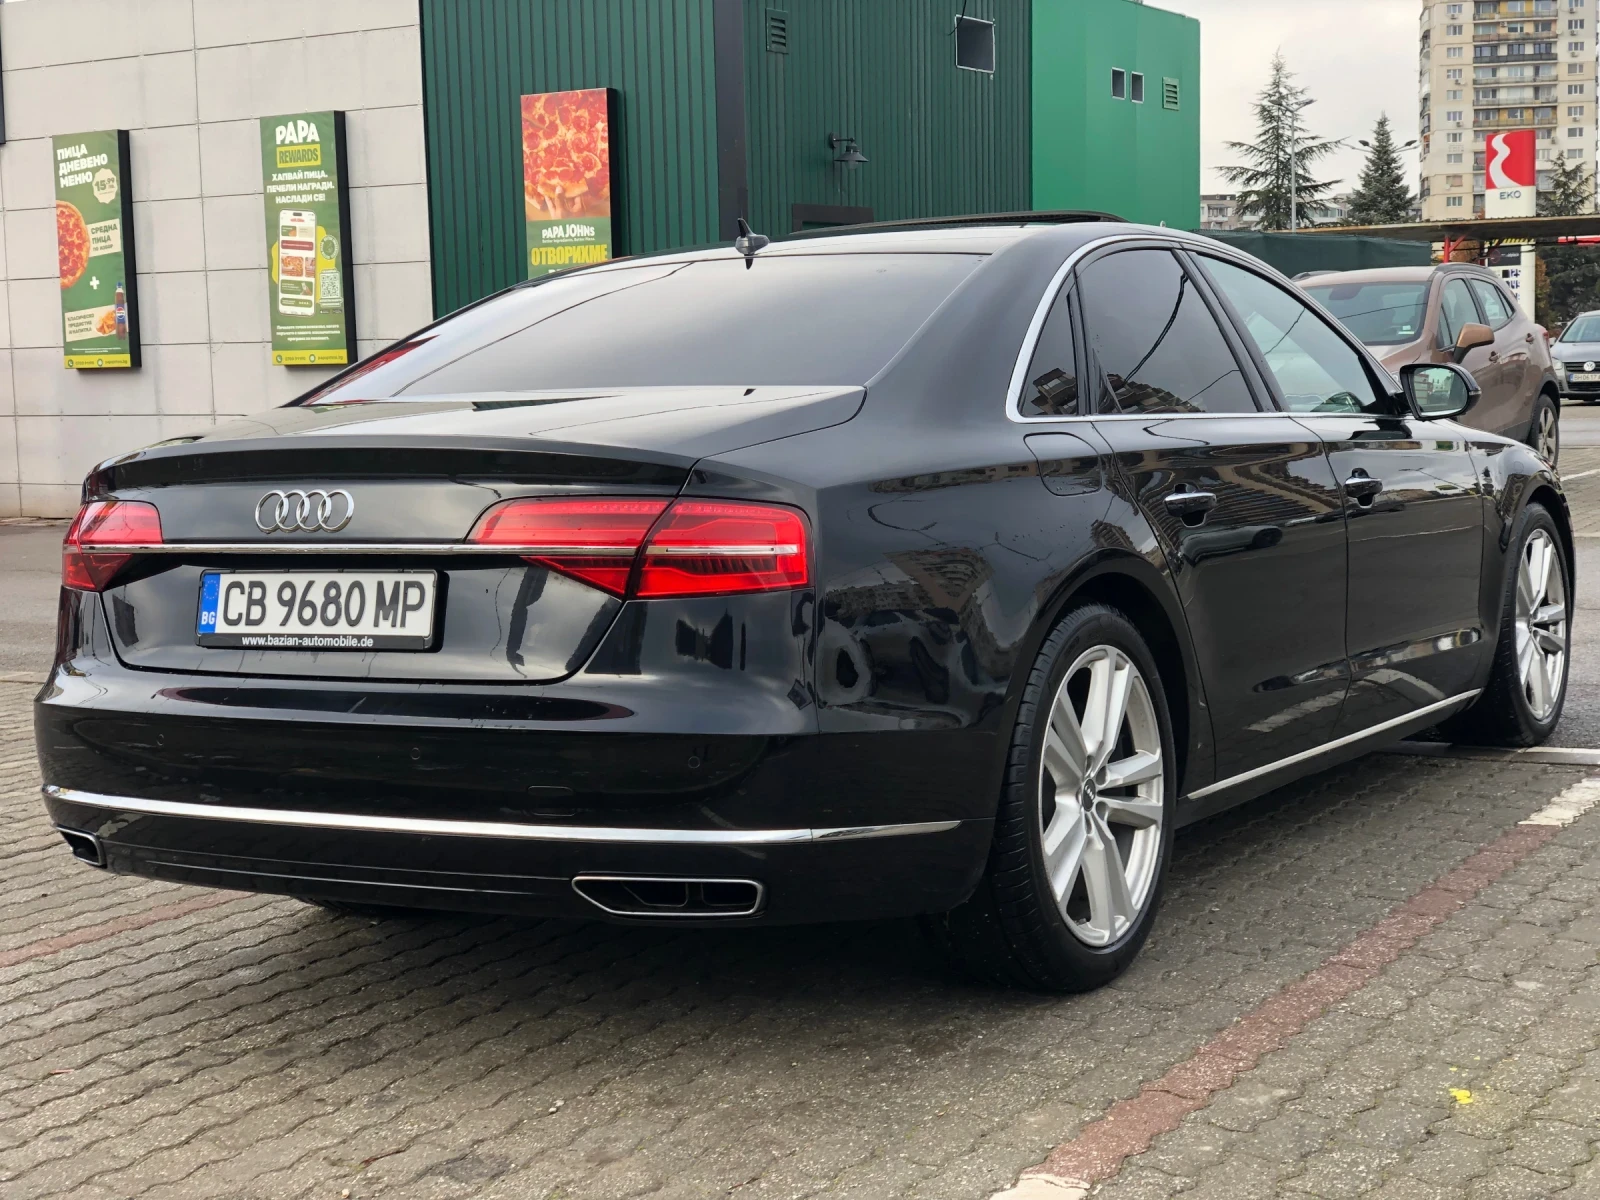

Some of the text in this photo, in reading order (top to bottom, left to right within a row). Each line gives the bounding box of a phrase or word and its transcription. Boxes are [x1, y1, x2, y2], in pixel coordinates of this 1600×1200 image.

[275, 120, 320, 145] PAPA
[56, 143, 88, 160] ПИЦА
[279, 148, 319, 164] REWARDS
[58, 153, 108, 176] ДНЕВЕНО
[60, 171, 93, 188] МЕНЮ
[271, 170, 303, 181] ХАПВАЙ
[266, 183, 297, 193] ПЕЧЕЛИ
[1499, 190, 1522, 200] EKO
[275, 193, 312, 204] НАСЛАДИ
[90, 223, 118, 235] СРЕДНА
[541, 223, 595, 239] PAPA JOHNS
[91, 235, 111, 244] ПИЦА
[531, 244, 608, 266] ОТВОРИХМЕ
[223, 580, 426, 628] CB 9680 MP
[201, 611, 216, 625] BG
[241, 634, 374, 648] www.bazian-automobile.de
